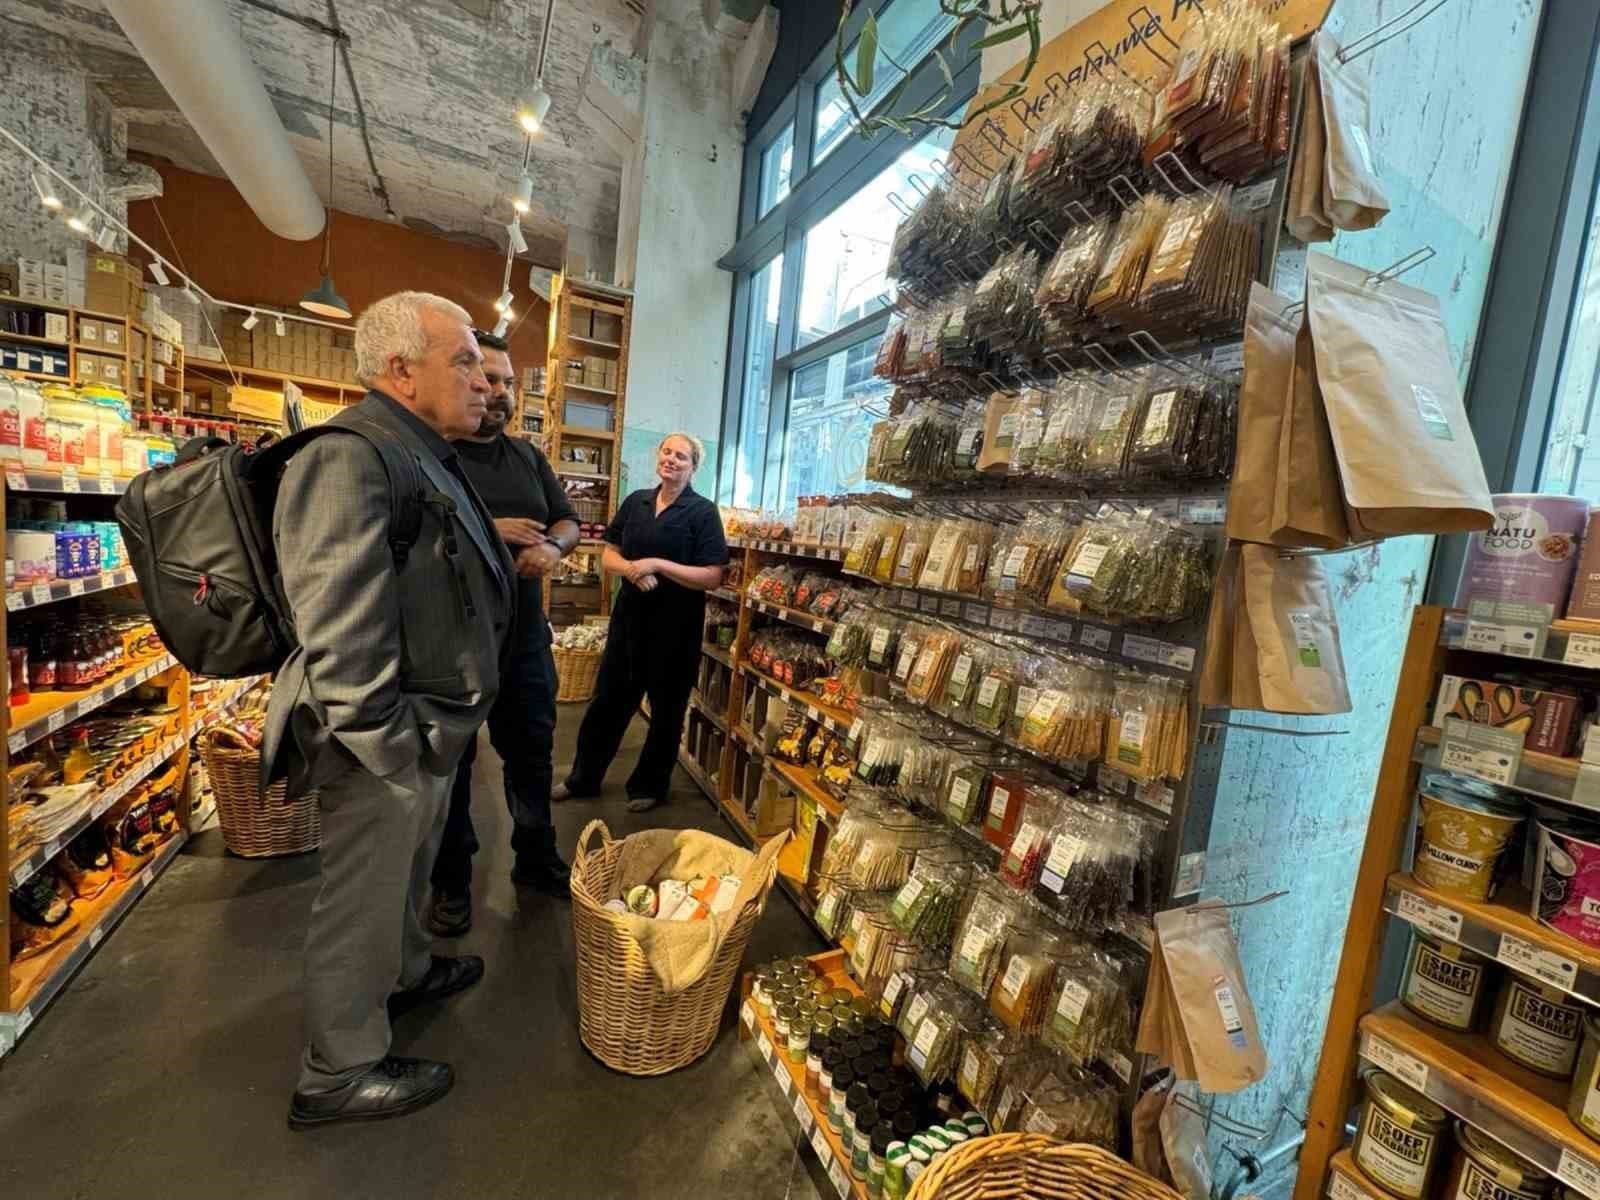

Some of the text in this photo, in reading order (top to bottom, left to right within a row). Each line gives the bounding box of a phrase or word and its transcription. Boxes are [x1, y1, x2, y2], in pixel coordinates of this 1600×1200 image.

[1483, 538, 1533, 550] FOOD
[1487, 527, 1537, 539] NATU
[1429, 955, 1472, 981] SOEP
[1525, 993, 1576, 1025] SOEP
[1381, 1121, 1424, 1149] SOEP
